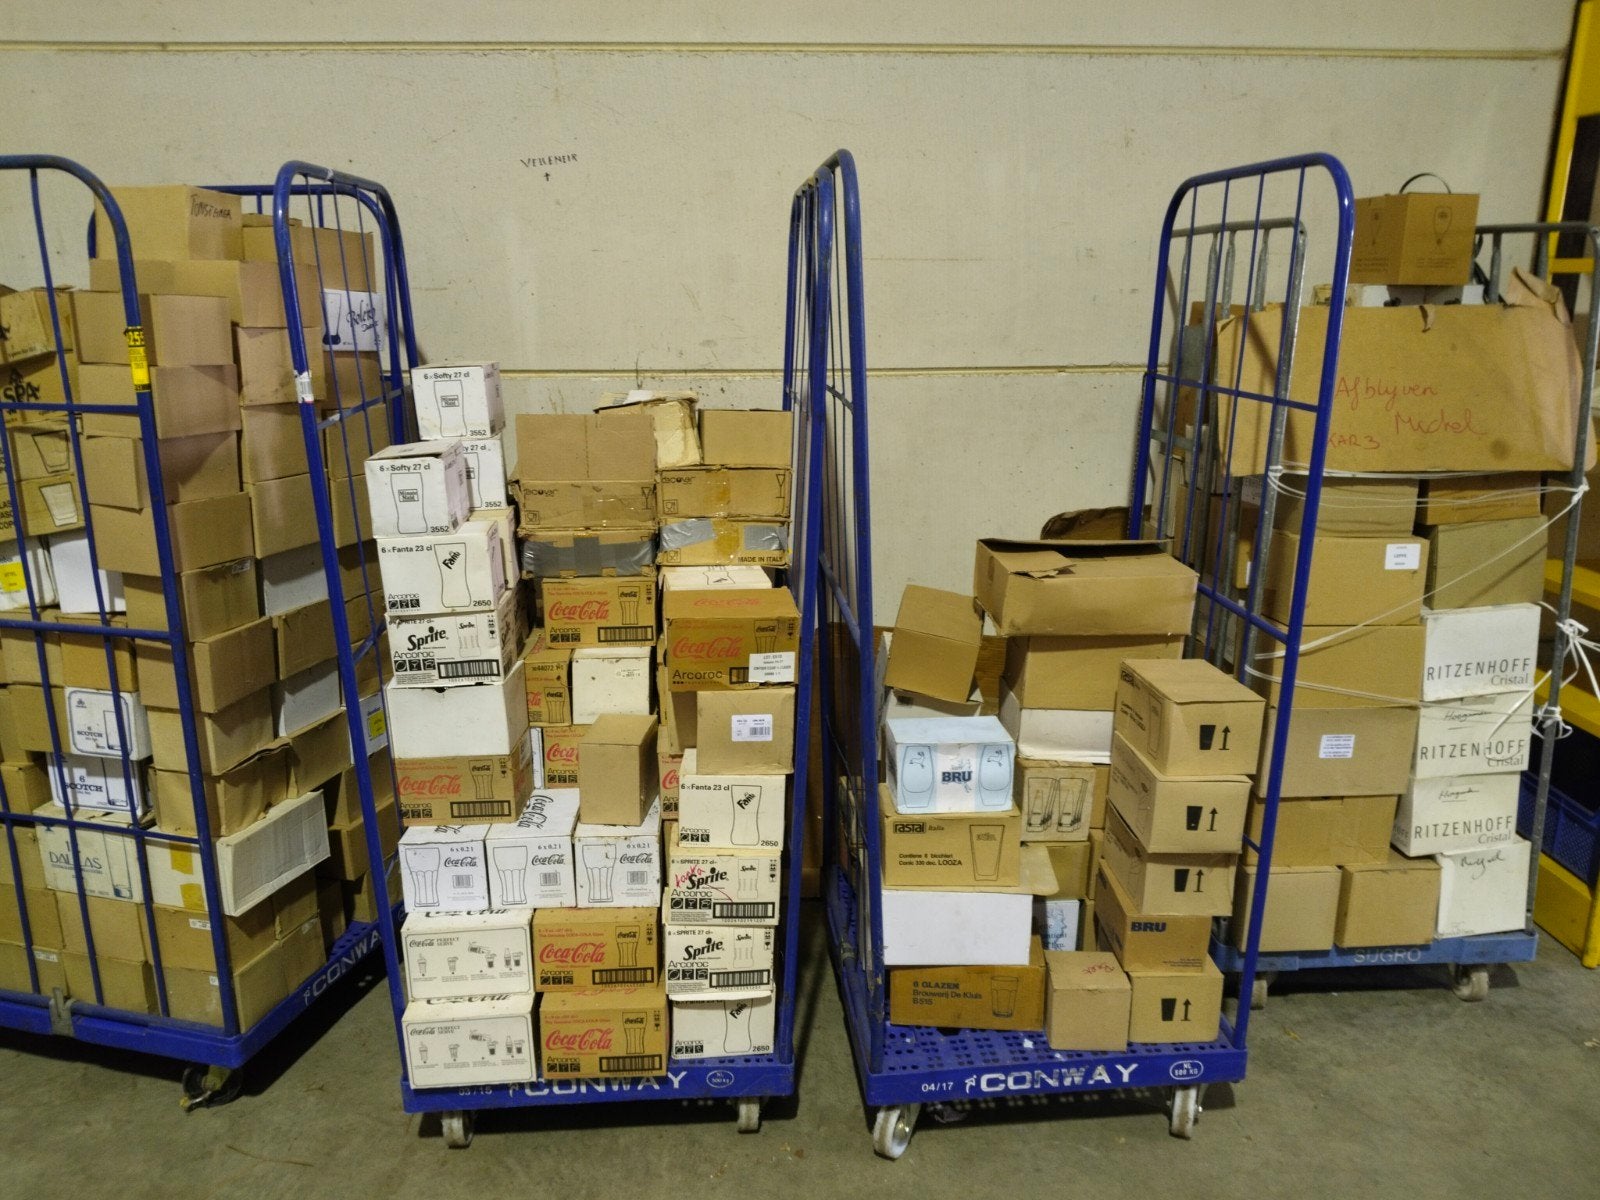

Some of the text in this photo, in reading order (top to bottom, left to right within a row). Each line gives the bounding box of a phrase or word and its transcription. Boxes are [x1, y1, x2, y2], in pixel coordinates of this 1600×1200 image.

[433, 372, 453, 380] Softy
[3, 381, 40, 402] SPA
[469, 429, 488, 437] 3552
[470, 444, 479, 452] 27
[390, 464, 411, 472] Softy
[412, 463, 422, 471] 27
[430, 525, 450, 533] 3552
[388, 592, 420, 600] Arcoroc
[548, 599, 610, 622] Coca-Cola
[407, 625, 447, 652] Sprite
[393, 650, 435, 659] Arcoroc
[671, 635, 744, 661] Coca-Cola
[672, 669, 724, 681] Arcoroc
[1426, 657, 1531, 681] RITZENHOFF
[1490, 673, 1529, 686] Cristal
[76, 730, 103, 738] SCOTCH
[1420, 739, 1526, 760] RITZENHOFF
[1486, 754, 1525, 768] Cristal
[78, 775, 86, 783] 6
[941, 770, 973, 783] BRU
[65, 782, 104, 793] SCOTCH
[397, 773, 463, 797] Coca-Cola
[893, 822, 926, 834] rastal
[1414, 815, 1513, 839] RITZENHOFF
[1477, 829, 1512, 845] Cristal
[49, 850, 103, 870] DALAS
[443, 856, 479, 868] Coca-Cola
[531, 853, 566, 866] Coca-Cola
[619, 852, 654, 865] Coca-Cola
[937, 859, 963, 867] LOOZA
[686, 866, 728, 891] Sprite
[671, 888, 713, 898] Arcoroc
[1130, 921, 1167, 933] BRU
[539, 942, 608, 964] Coca-Cola
[683, 937, 725, 961] Sprite
[1353, 947, 1422, 963] SUGRO
[312, 929, 382, 998] CONWA
[667, 960, 709, 968] Arcoroc
[921, 981, 960, 990] GLAZEN
[912, 989, 949, 999] Brouwerij
[950, 991, 961, 999] De
[545, 1027, 615, 1052] Coca-Cola
[524, 1070, 689, 1097] CONWAY
[980, 1062, 1139, 1093] CONWAY
[921, 1081, 954, 1093] 04/17
